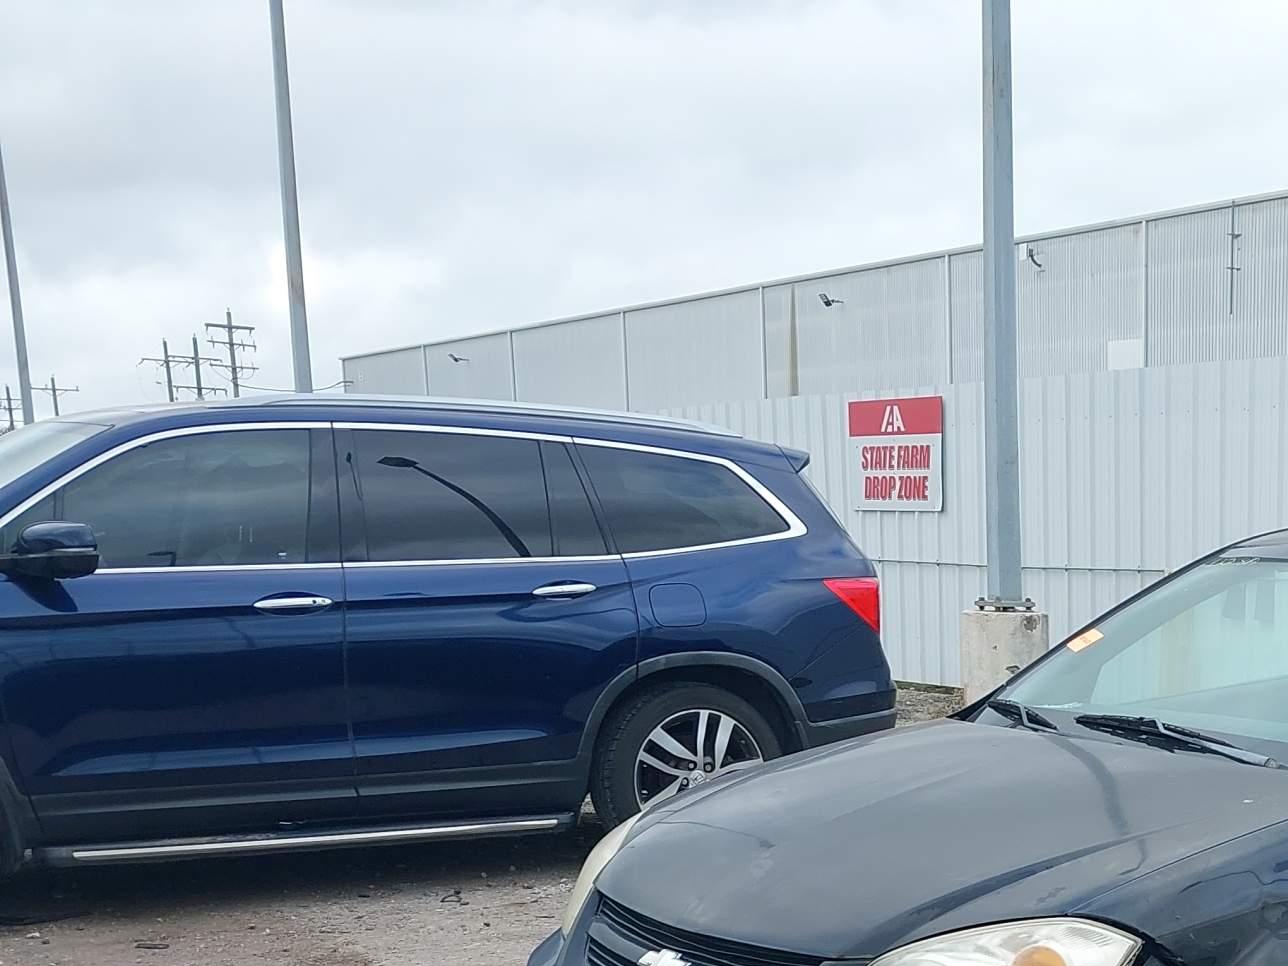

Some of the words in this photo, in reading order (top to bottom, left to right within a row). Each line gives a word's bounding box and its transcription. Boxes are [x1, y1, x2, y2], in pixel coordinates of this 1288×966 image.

[861, 445, 895, 471] STATE
[896, 444, 931, 470] FARM
[864, 475, 896, 501] DROP
[897, 475, 929, 501] ZONE
